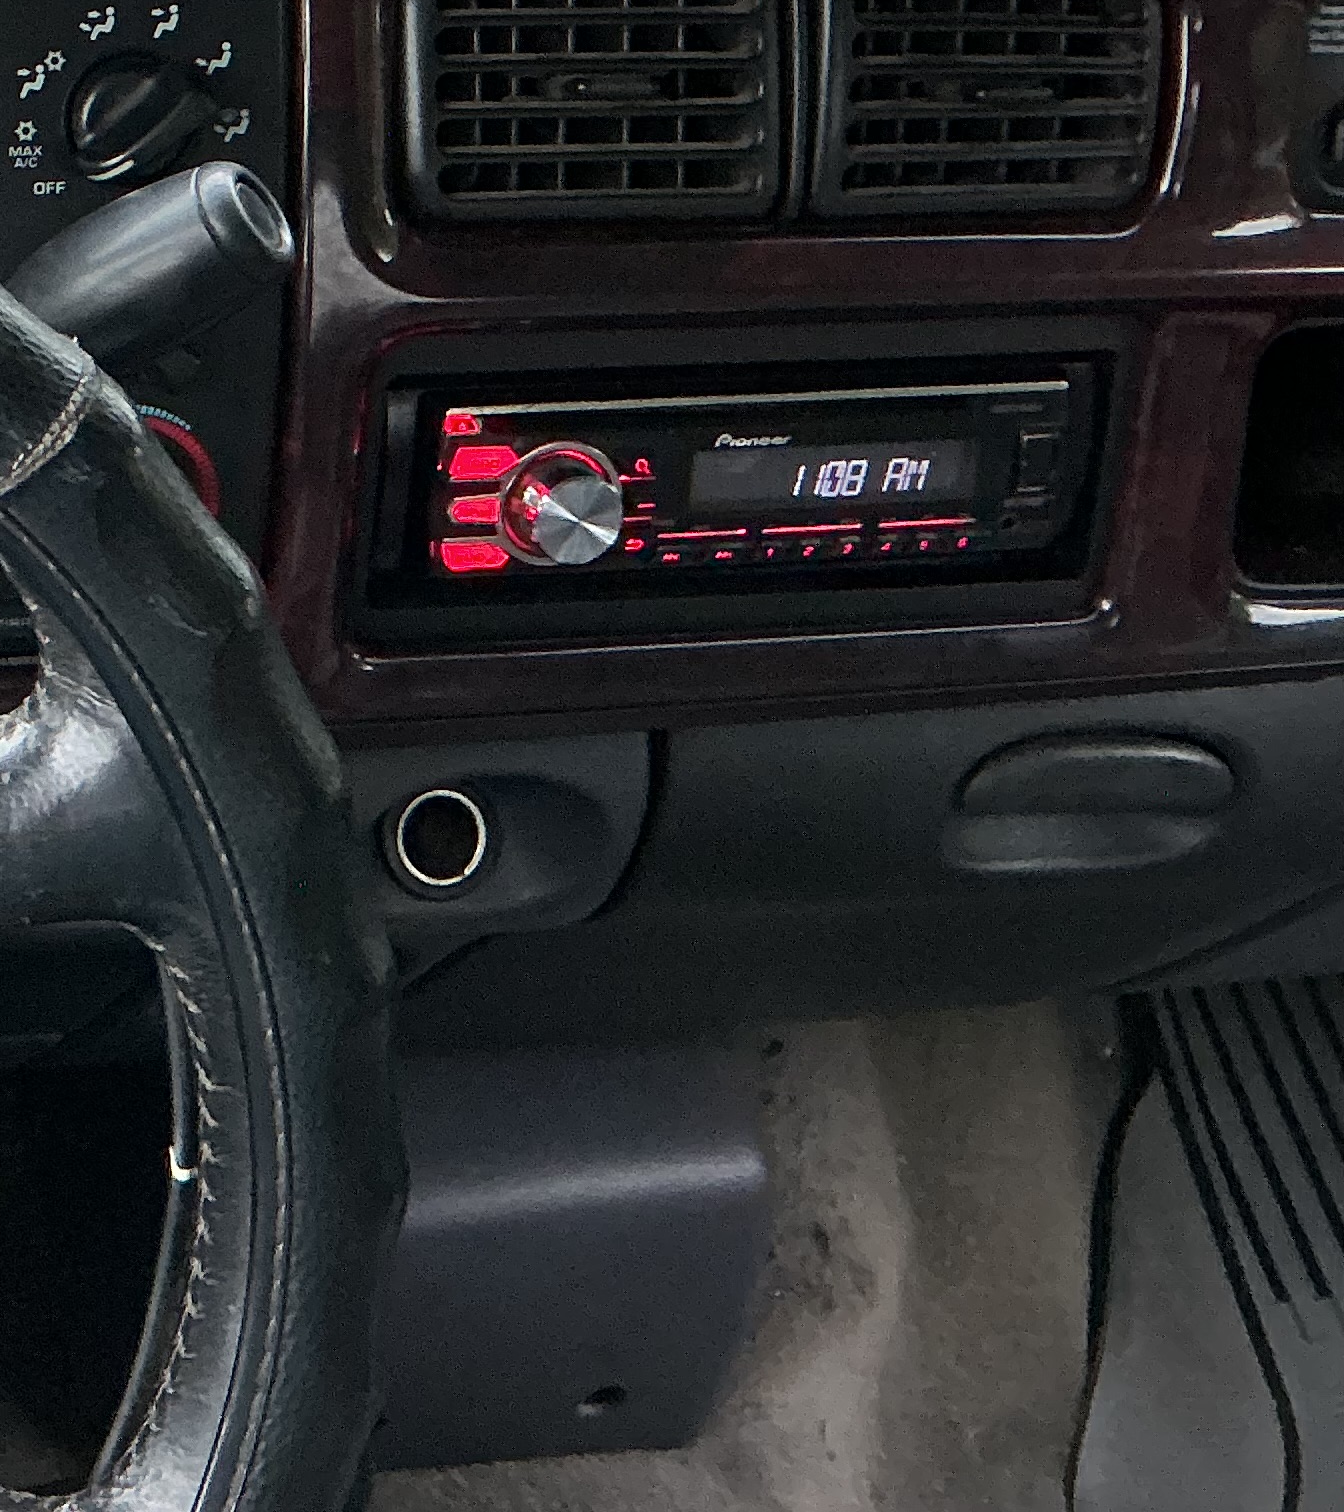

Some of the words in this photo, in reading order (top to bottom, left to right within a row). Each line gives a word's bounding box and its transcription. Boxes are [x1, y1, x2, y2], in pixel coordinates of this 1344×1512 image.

[8, 145, 43, 158] MAX
[13, 157, 38, 169] A/C
[32, 180, 67, 196] OFF
[714, 433, 793, 448] Pioneer
[881, 457, 931, 492] AM
